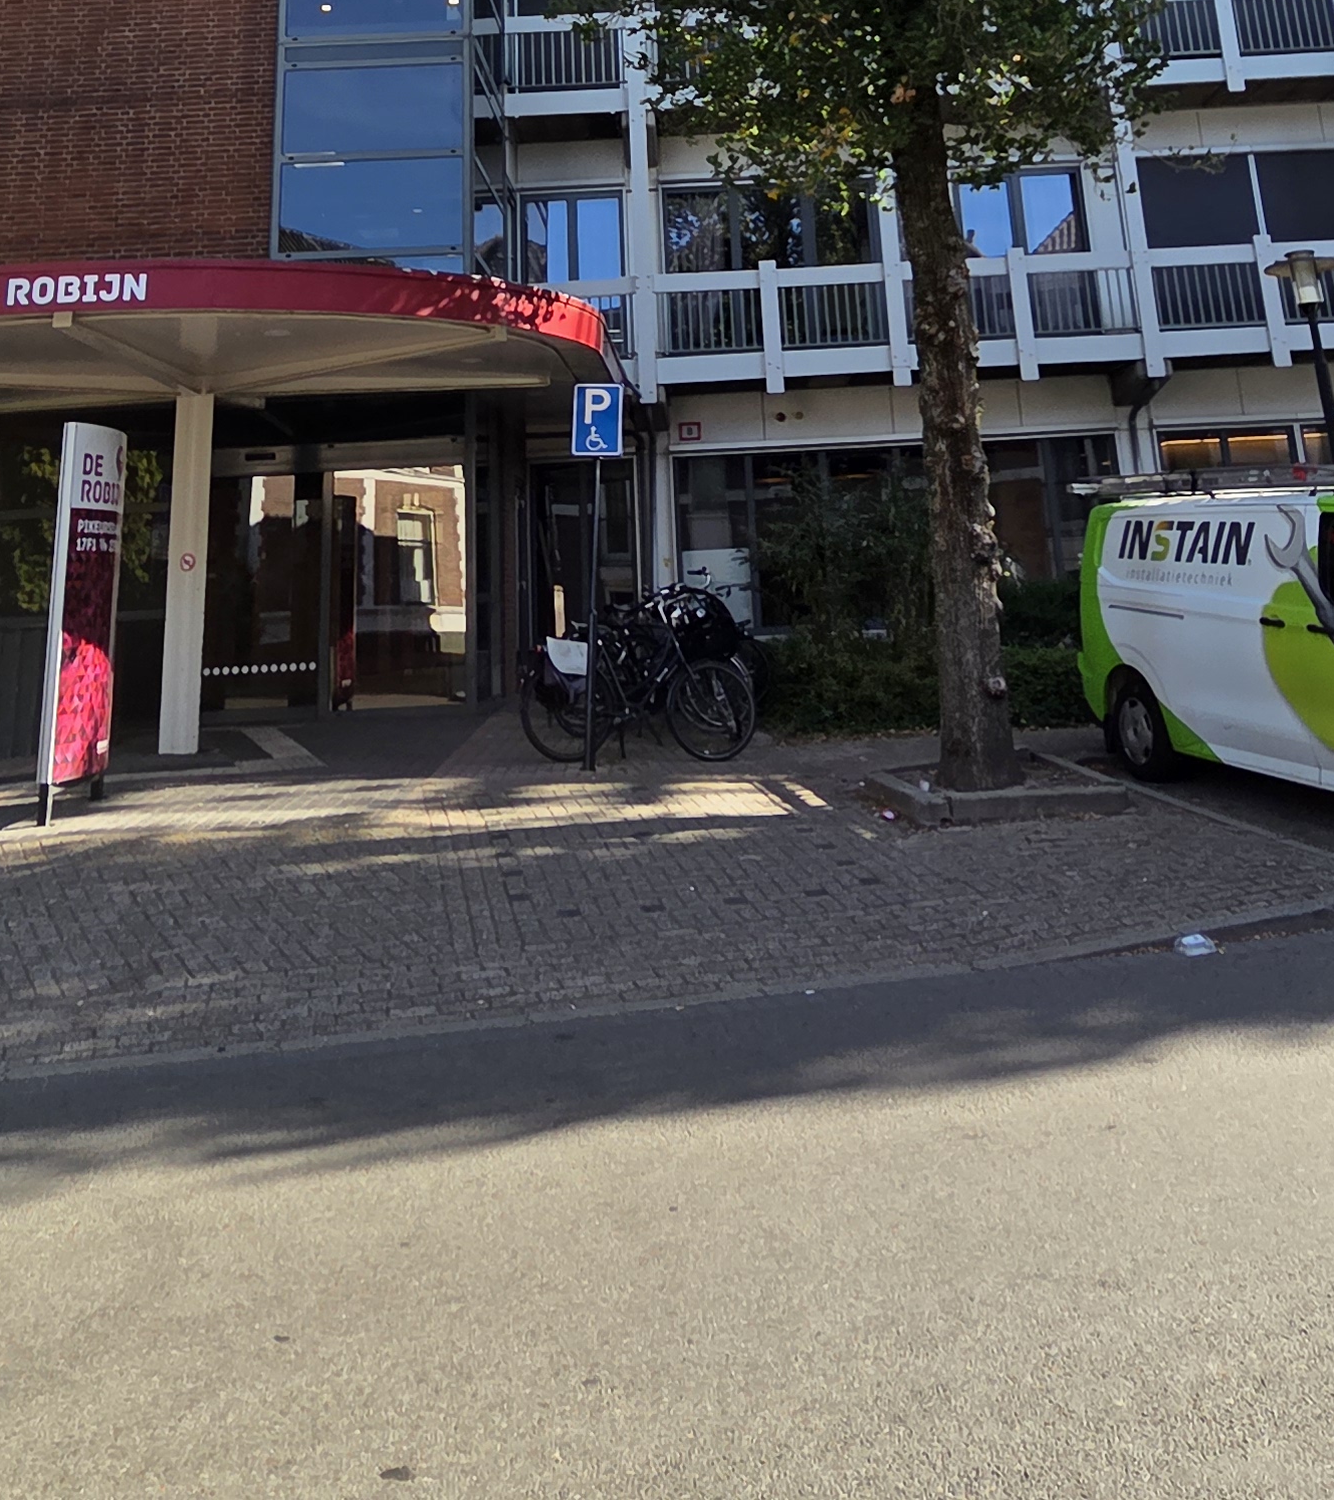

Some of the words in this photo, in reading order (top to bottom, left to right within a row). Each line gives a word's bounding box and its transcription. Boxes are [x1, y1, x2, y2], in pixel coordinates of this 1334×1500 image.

[6, 273, 148, 306] ROBIJN
[584, 388, 612, 425] P
[82, 452, 104, 477] DE
[1118, 520, 1256, 566] INSTAIN
[1125, 567, 1233, 587] installatietechniek
